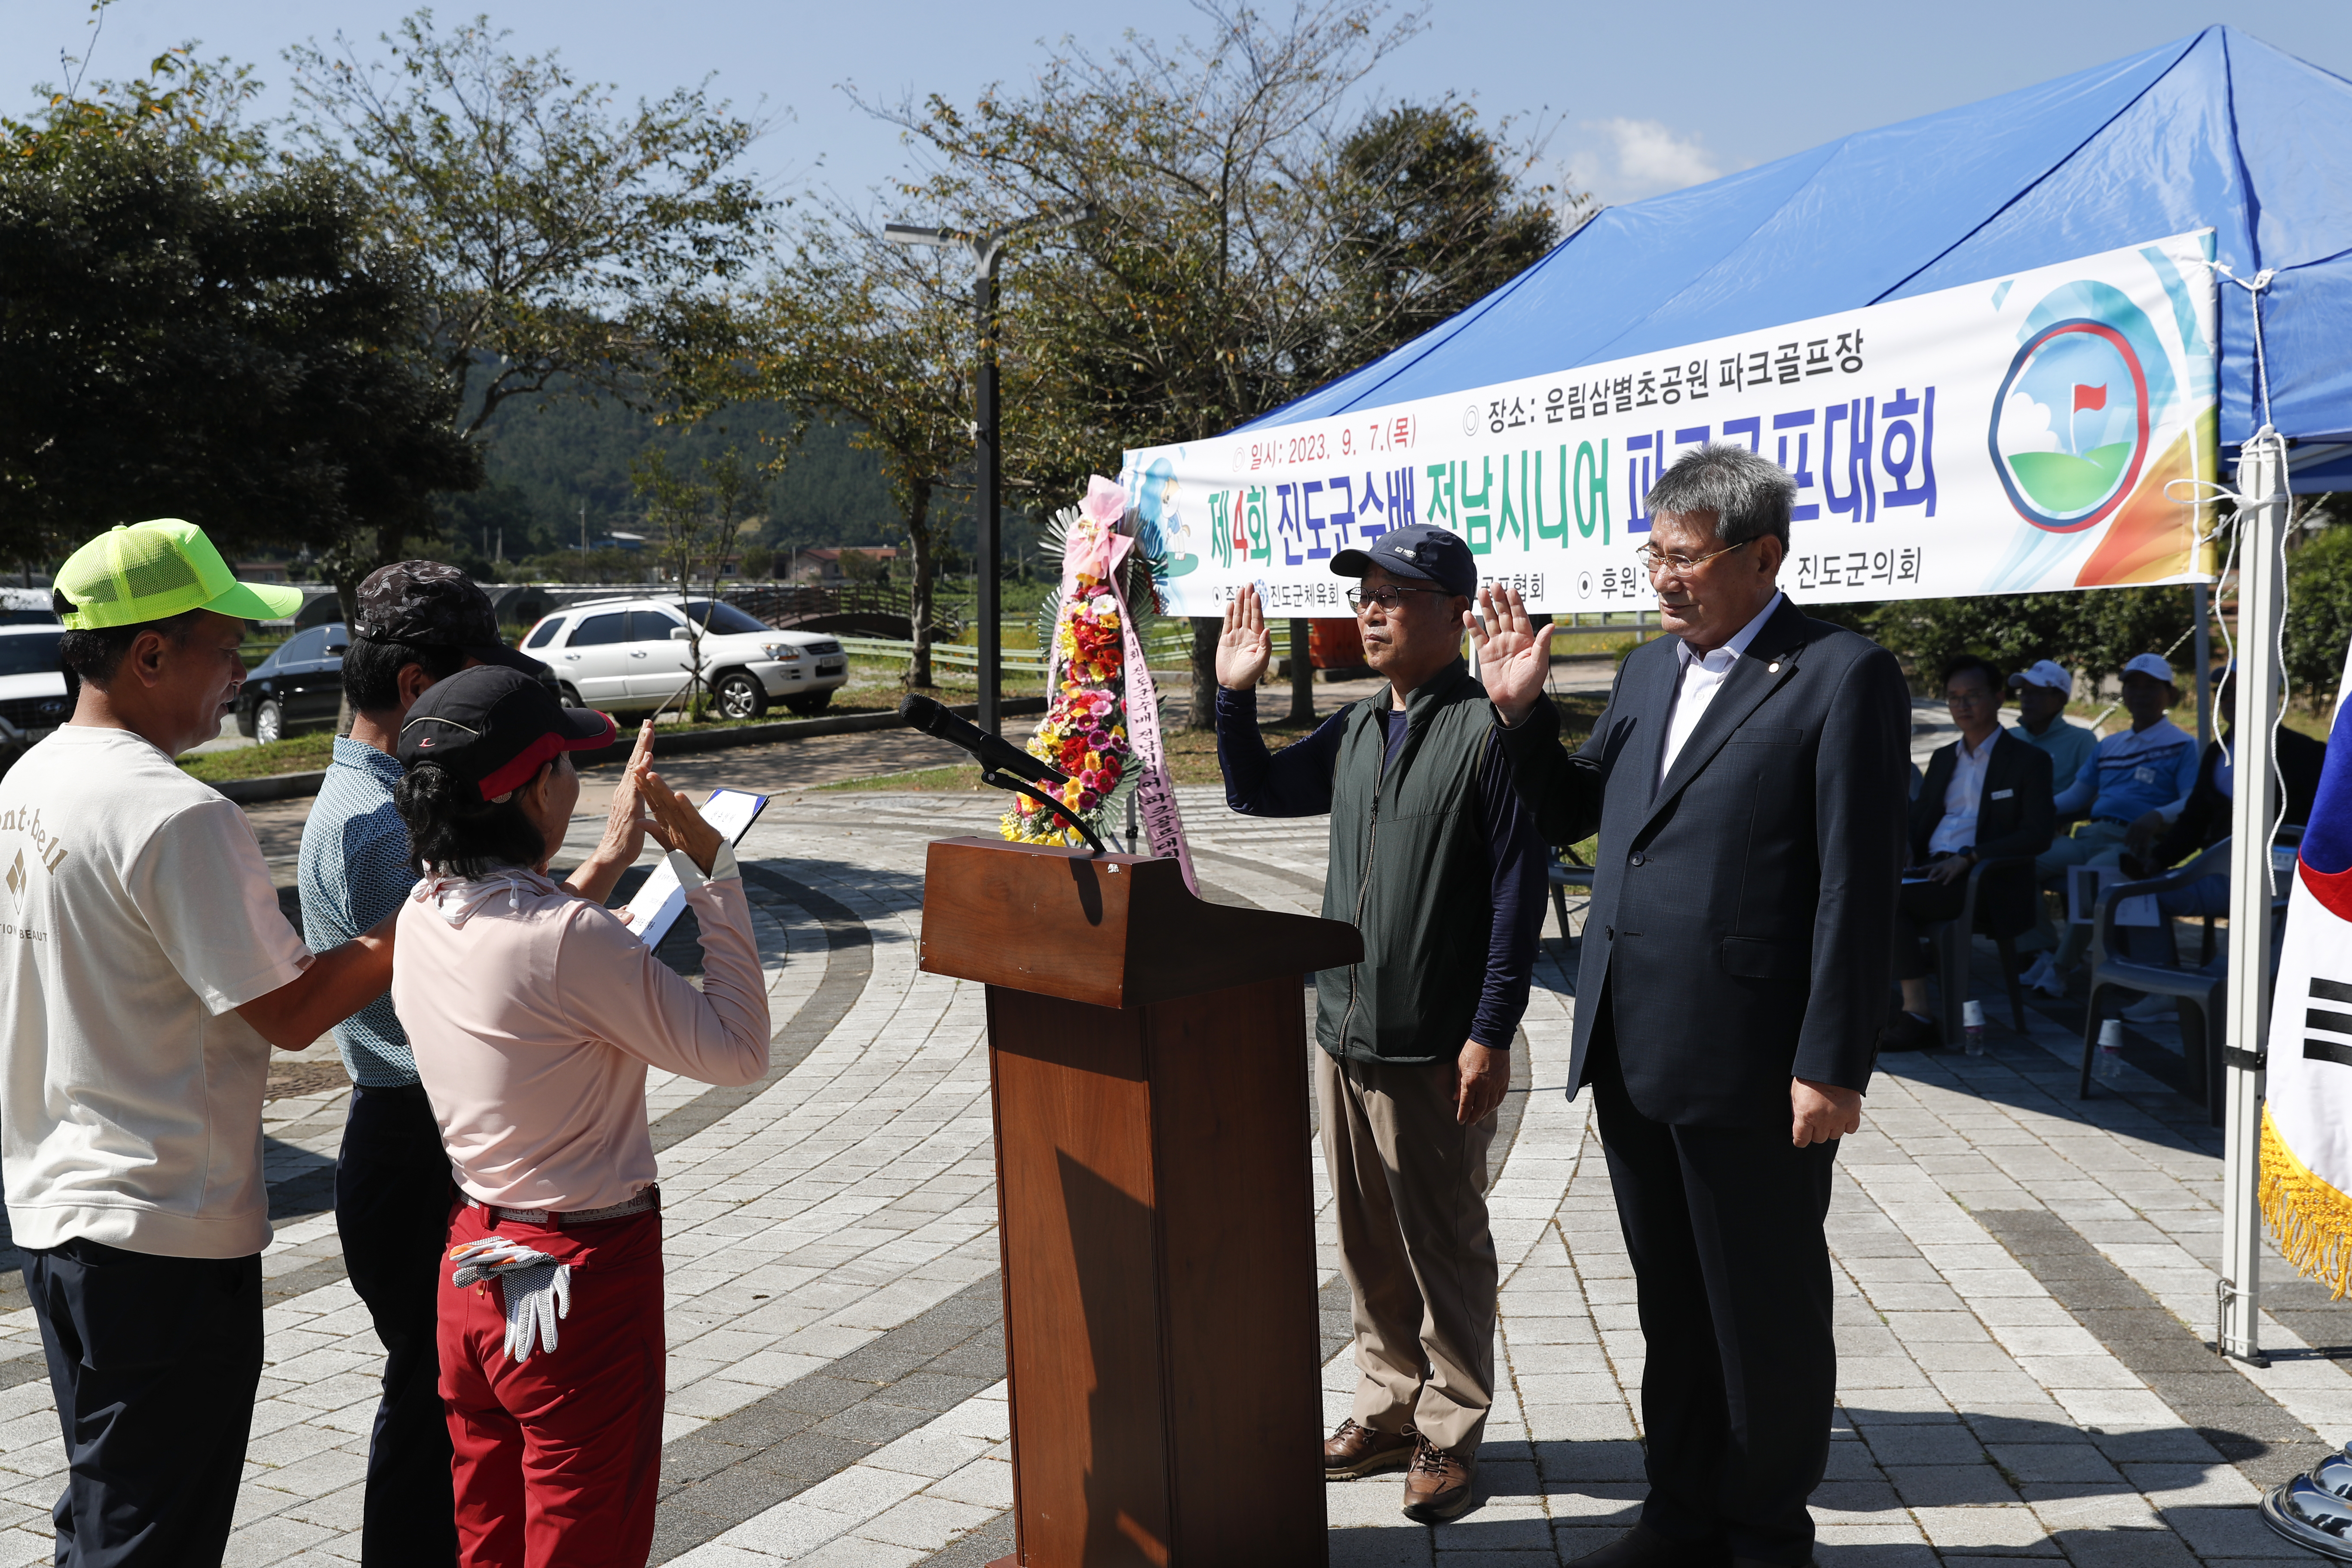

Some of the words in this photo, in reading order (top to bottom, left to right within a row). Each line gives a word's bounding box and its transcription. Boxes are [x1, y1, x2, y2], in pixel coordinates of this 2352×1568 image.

[1488, 396, 1535, 434] 장소:
[1545, 359, 1709, 424] 운림삼별초공원
[1719, 328, 1864, 393] 파크골프장
[1251, 440, 1283, 470] 일시:
[1289, 433, 1330, 463] 2023.
[1342, 429, 1357, 456] 9.
[1208, 485, 1271, 568] 제4회
[1427, 438, 1610, 555] 전남시니어
[1627, 386, 1937, 534] 파프대회
[1403, 548, 1416, 557] NEPA
[1798, 546, 1921, 589] 진도군의회
[1271, 583, 1338, 607] 진도군체육회
[1601, 567, 1645, 599] 후원:
